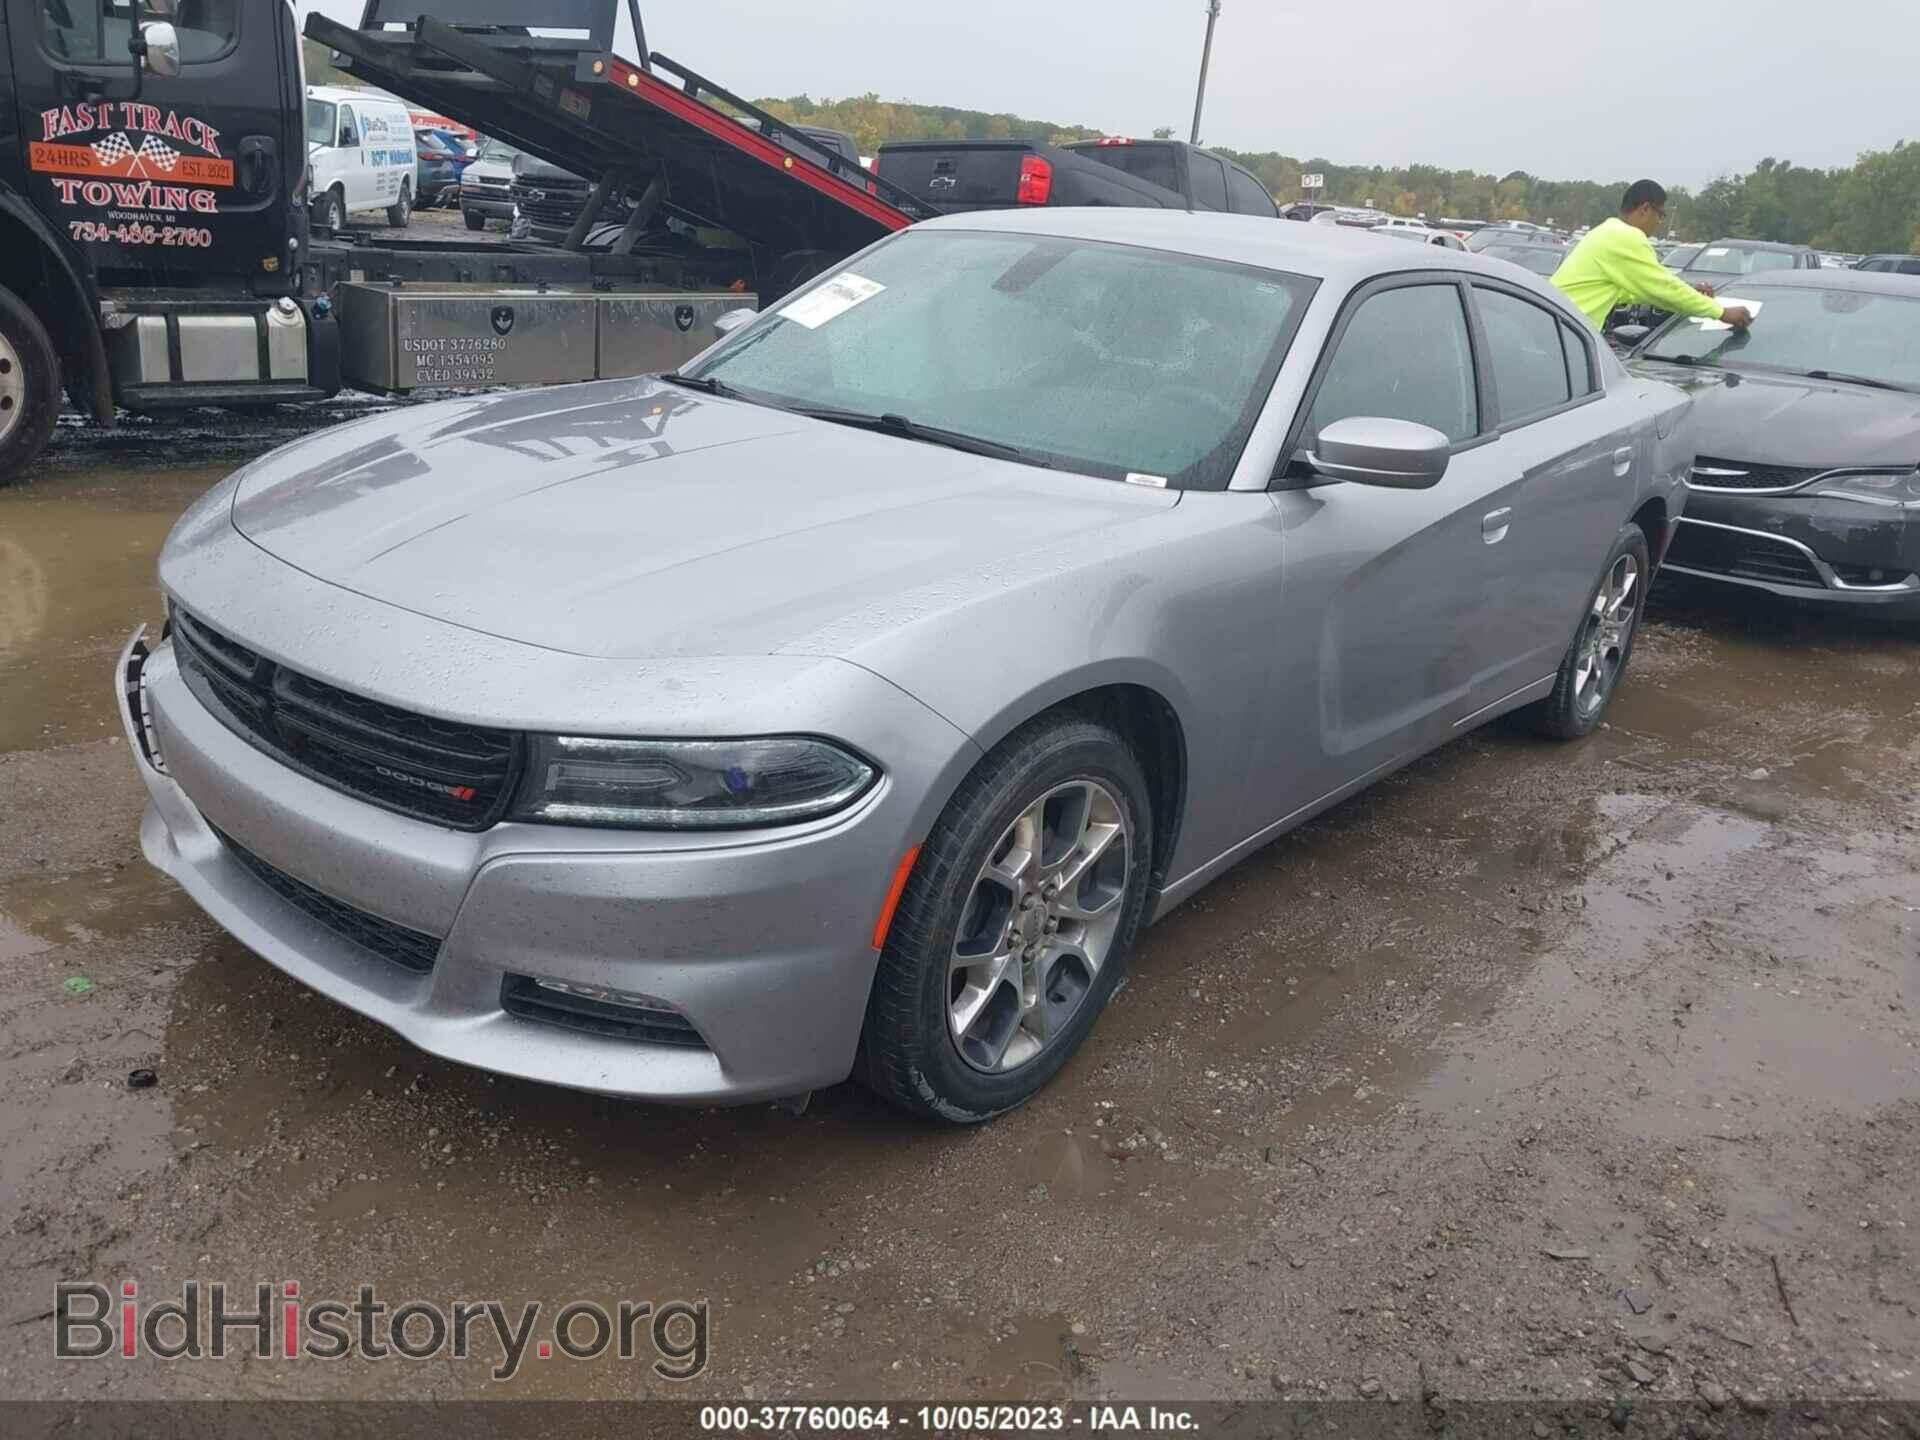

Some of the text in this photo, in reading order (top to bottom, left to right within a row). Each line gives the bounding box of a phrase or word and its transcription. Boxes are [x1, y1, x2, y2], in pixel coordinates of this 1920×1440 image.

[41, 102, 223, 158] FAST TRACK
[33, 147, 91, 169] 24HRS
[182, 161, 231, 180] EST. 2021
[51, 178, 219, 214] TOWING
[404, 337, 506, 351] USDOT 3776280
[416, 353, 434, 367] MC
